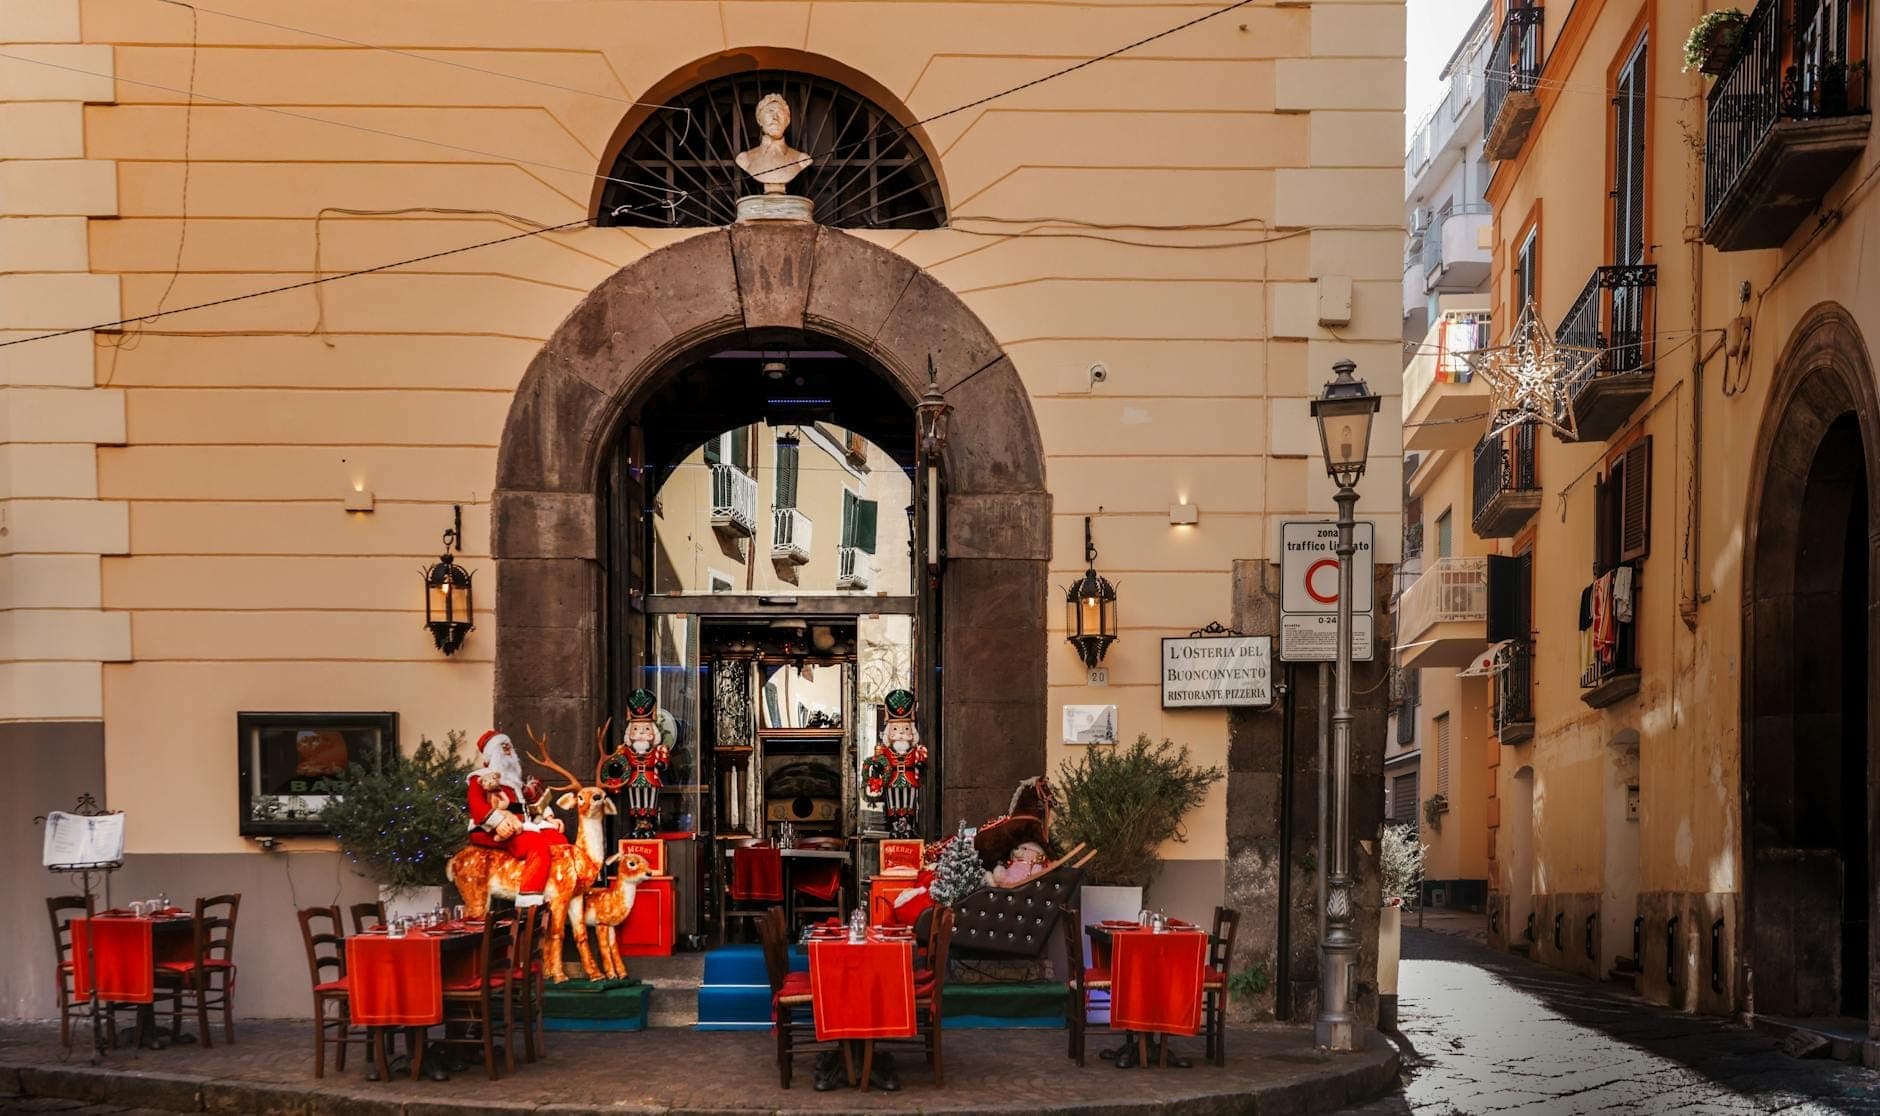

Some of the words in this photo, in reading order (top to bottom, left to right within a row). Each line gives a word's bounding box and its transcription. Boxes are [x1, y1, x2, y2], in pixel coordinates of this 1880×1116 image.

[1317, 529, 1339, 538] zona
[1287, 540, 1326, 551] traffico
[1170, 646, 1235, 660] L'OSTERIA
[1240, 646, 1263, 657] DEL
[1091, 672, 1105, 682] 20
[1168, 667, 1266, 681] BUONCONVENTO
[1168, 689, 1223, 701] RISTORANTE
[1225, 687, 1266, 699] PIZZERIA
